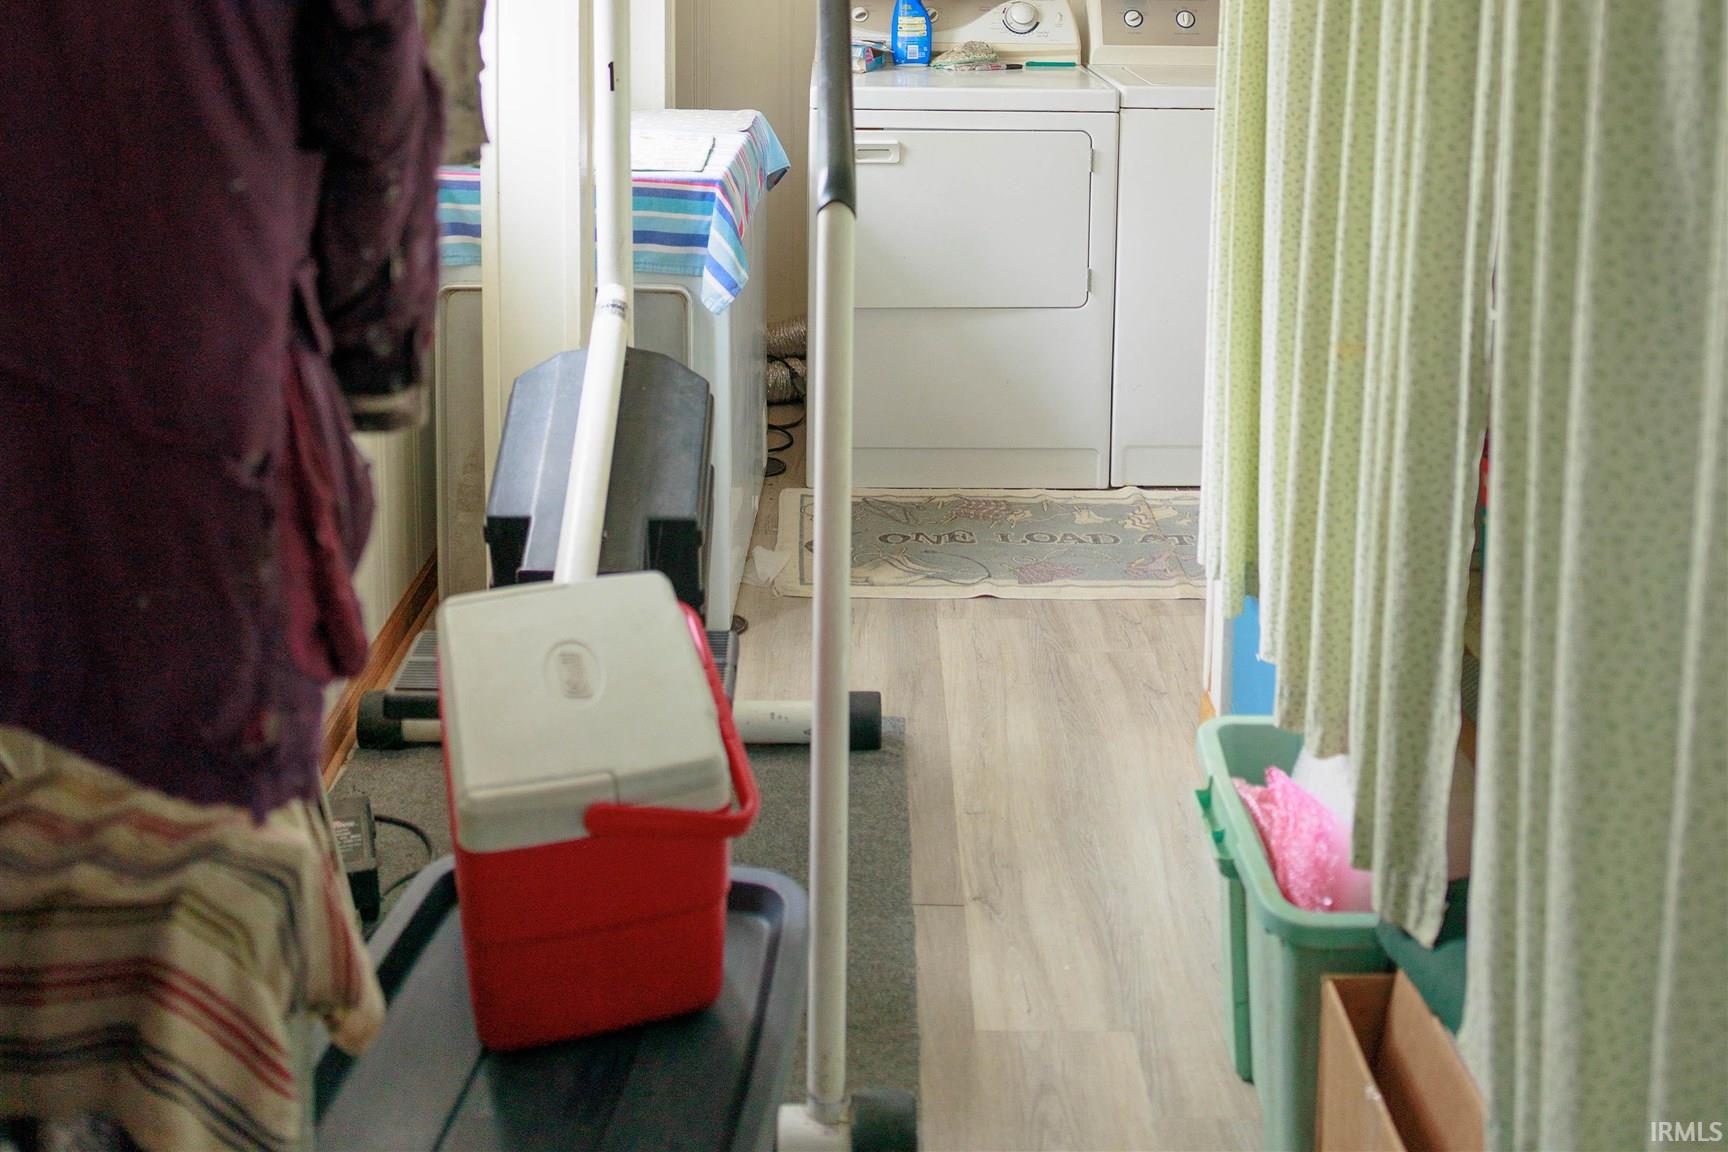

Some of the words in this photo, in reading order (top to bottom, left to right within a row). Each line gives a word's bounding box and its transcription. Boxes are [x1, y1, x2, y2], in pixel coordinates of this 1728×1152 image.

[878, 530, 977, 545] ONE
[998, 532, 1121, 546] LOAD
[1140, 532, 1195, 546] AT
